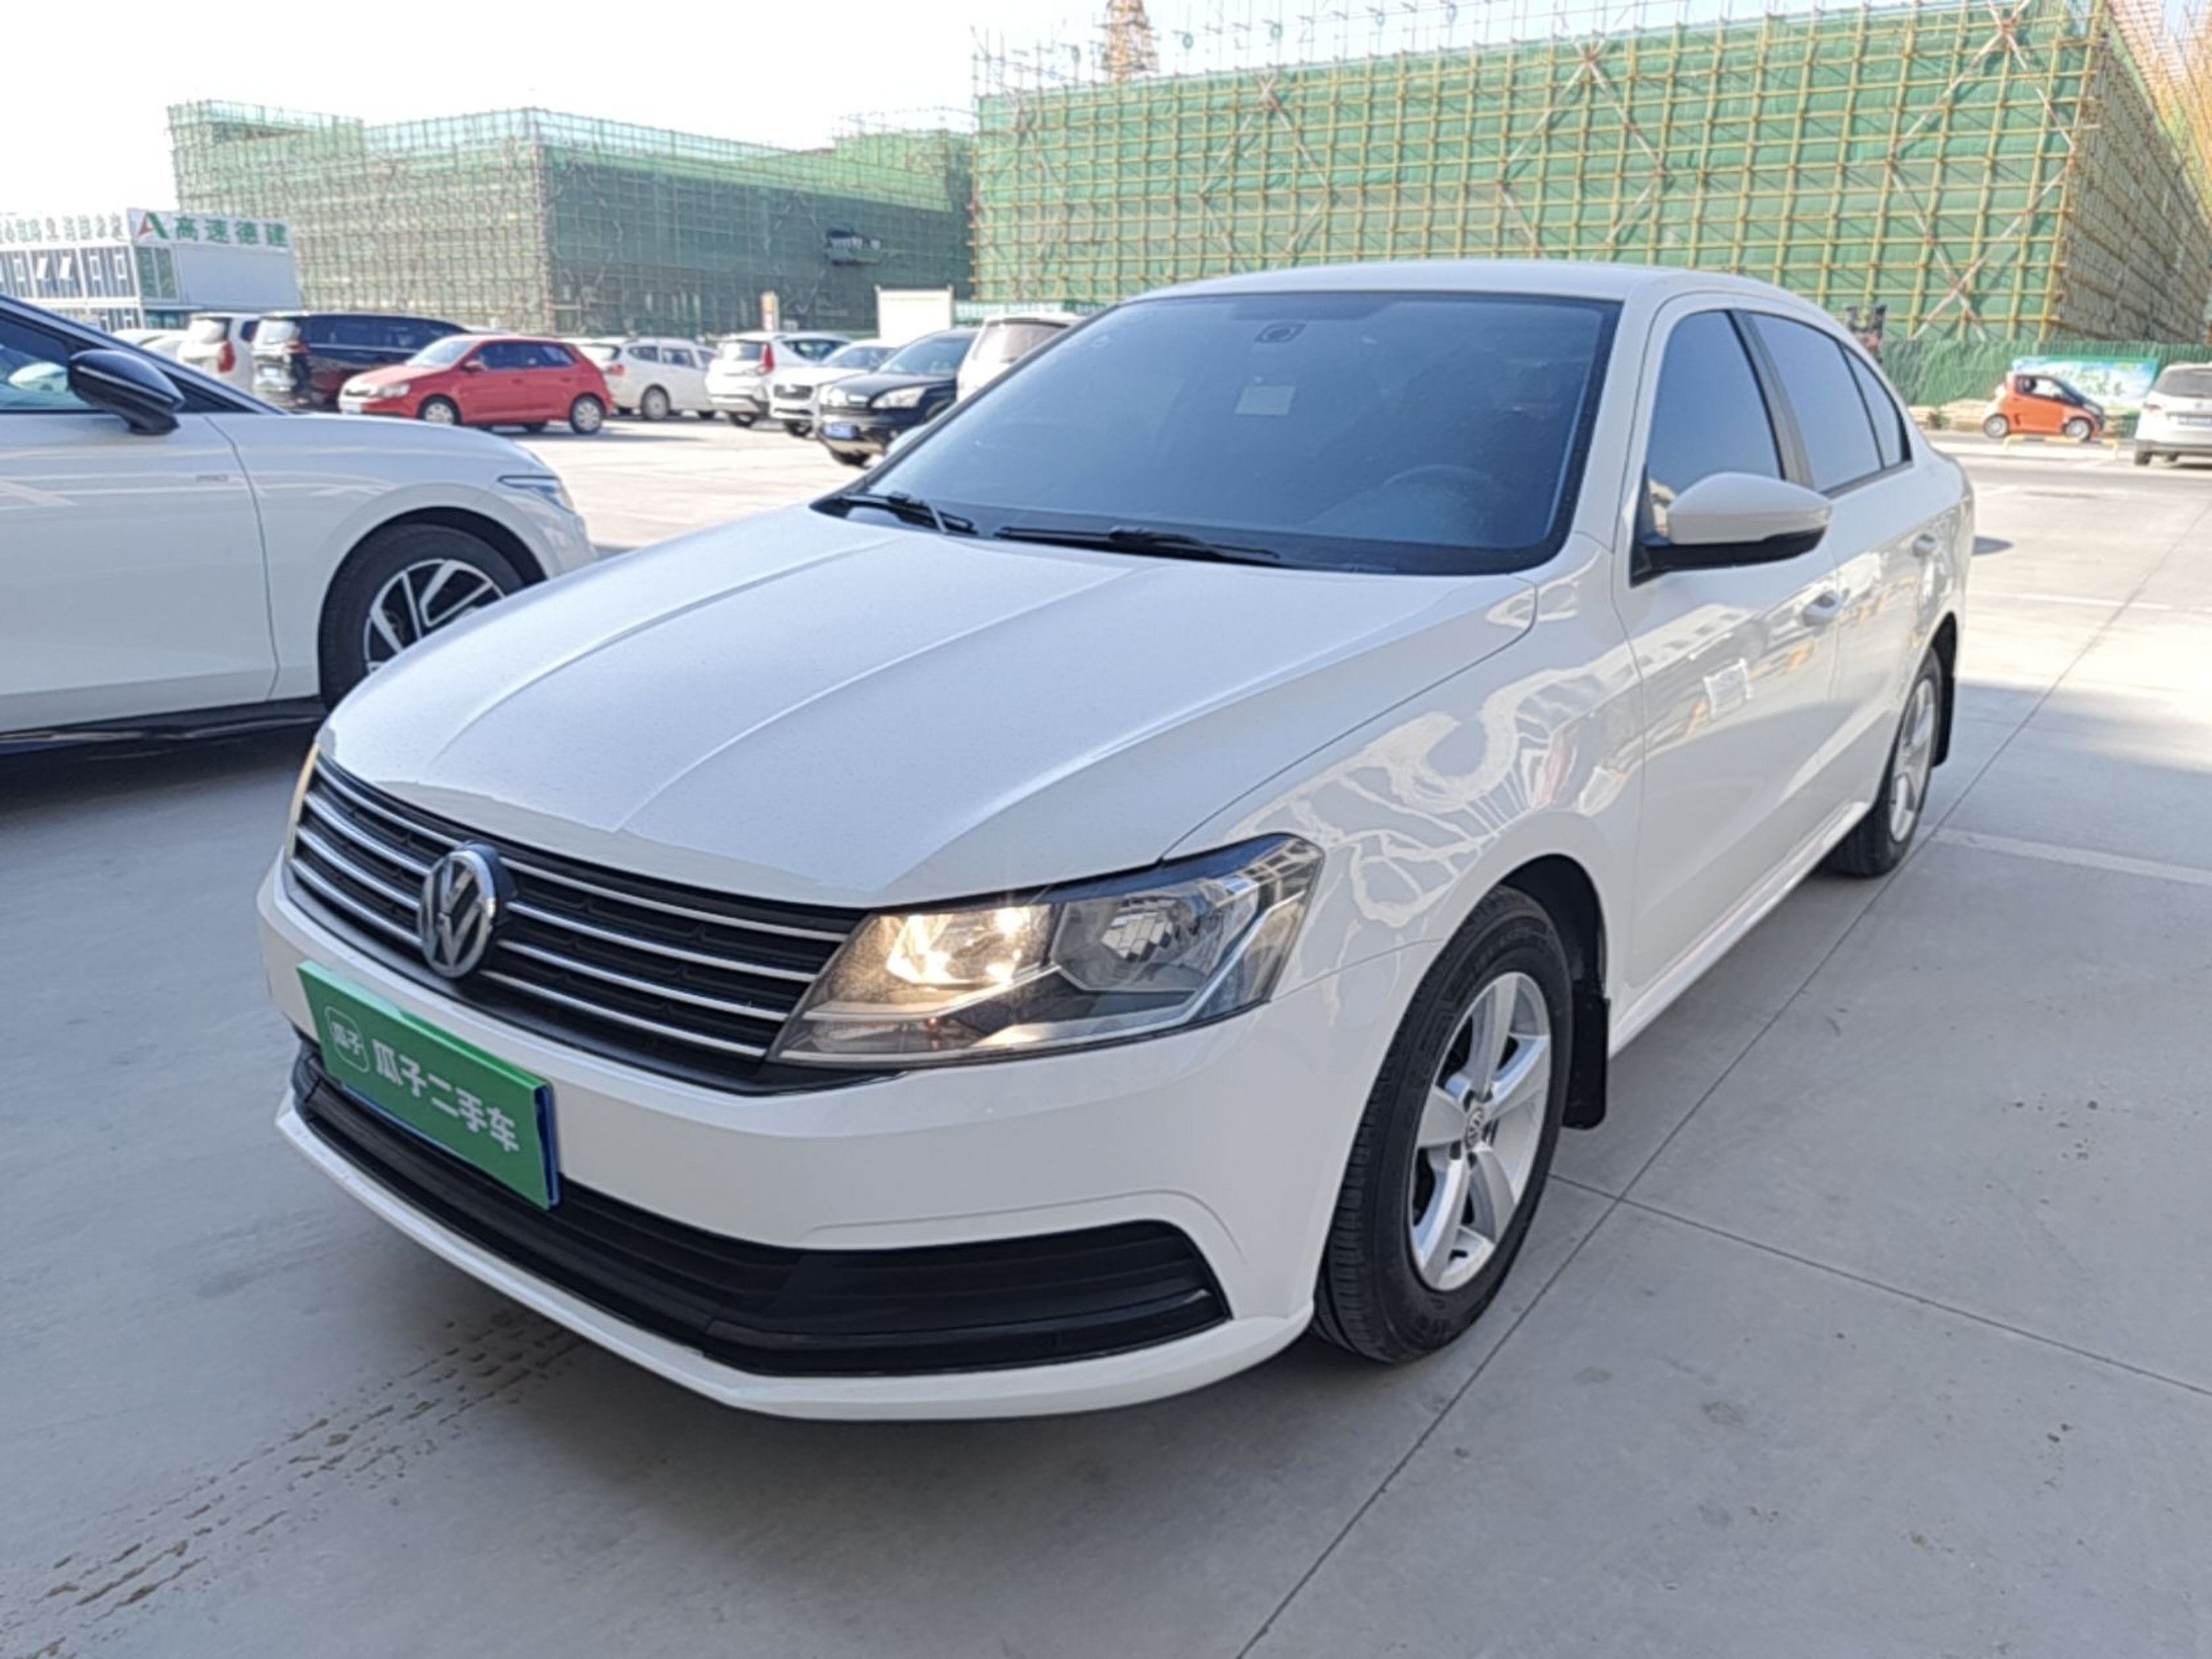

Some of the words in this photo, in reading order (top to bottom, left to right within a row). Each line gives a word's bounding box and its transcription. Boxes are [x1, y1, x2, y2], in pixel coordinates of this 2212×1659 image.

[372, 1037, 520, 1153] 瓜子二手车
